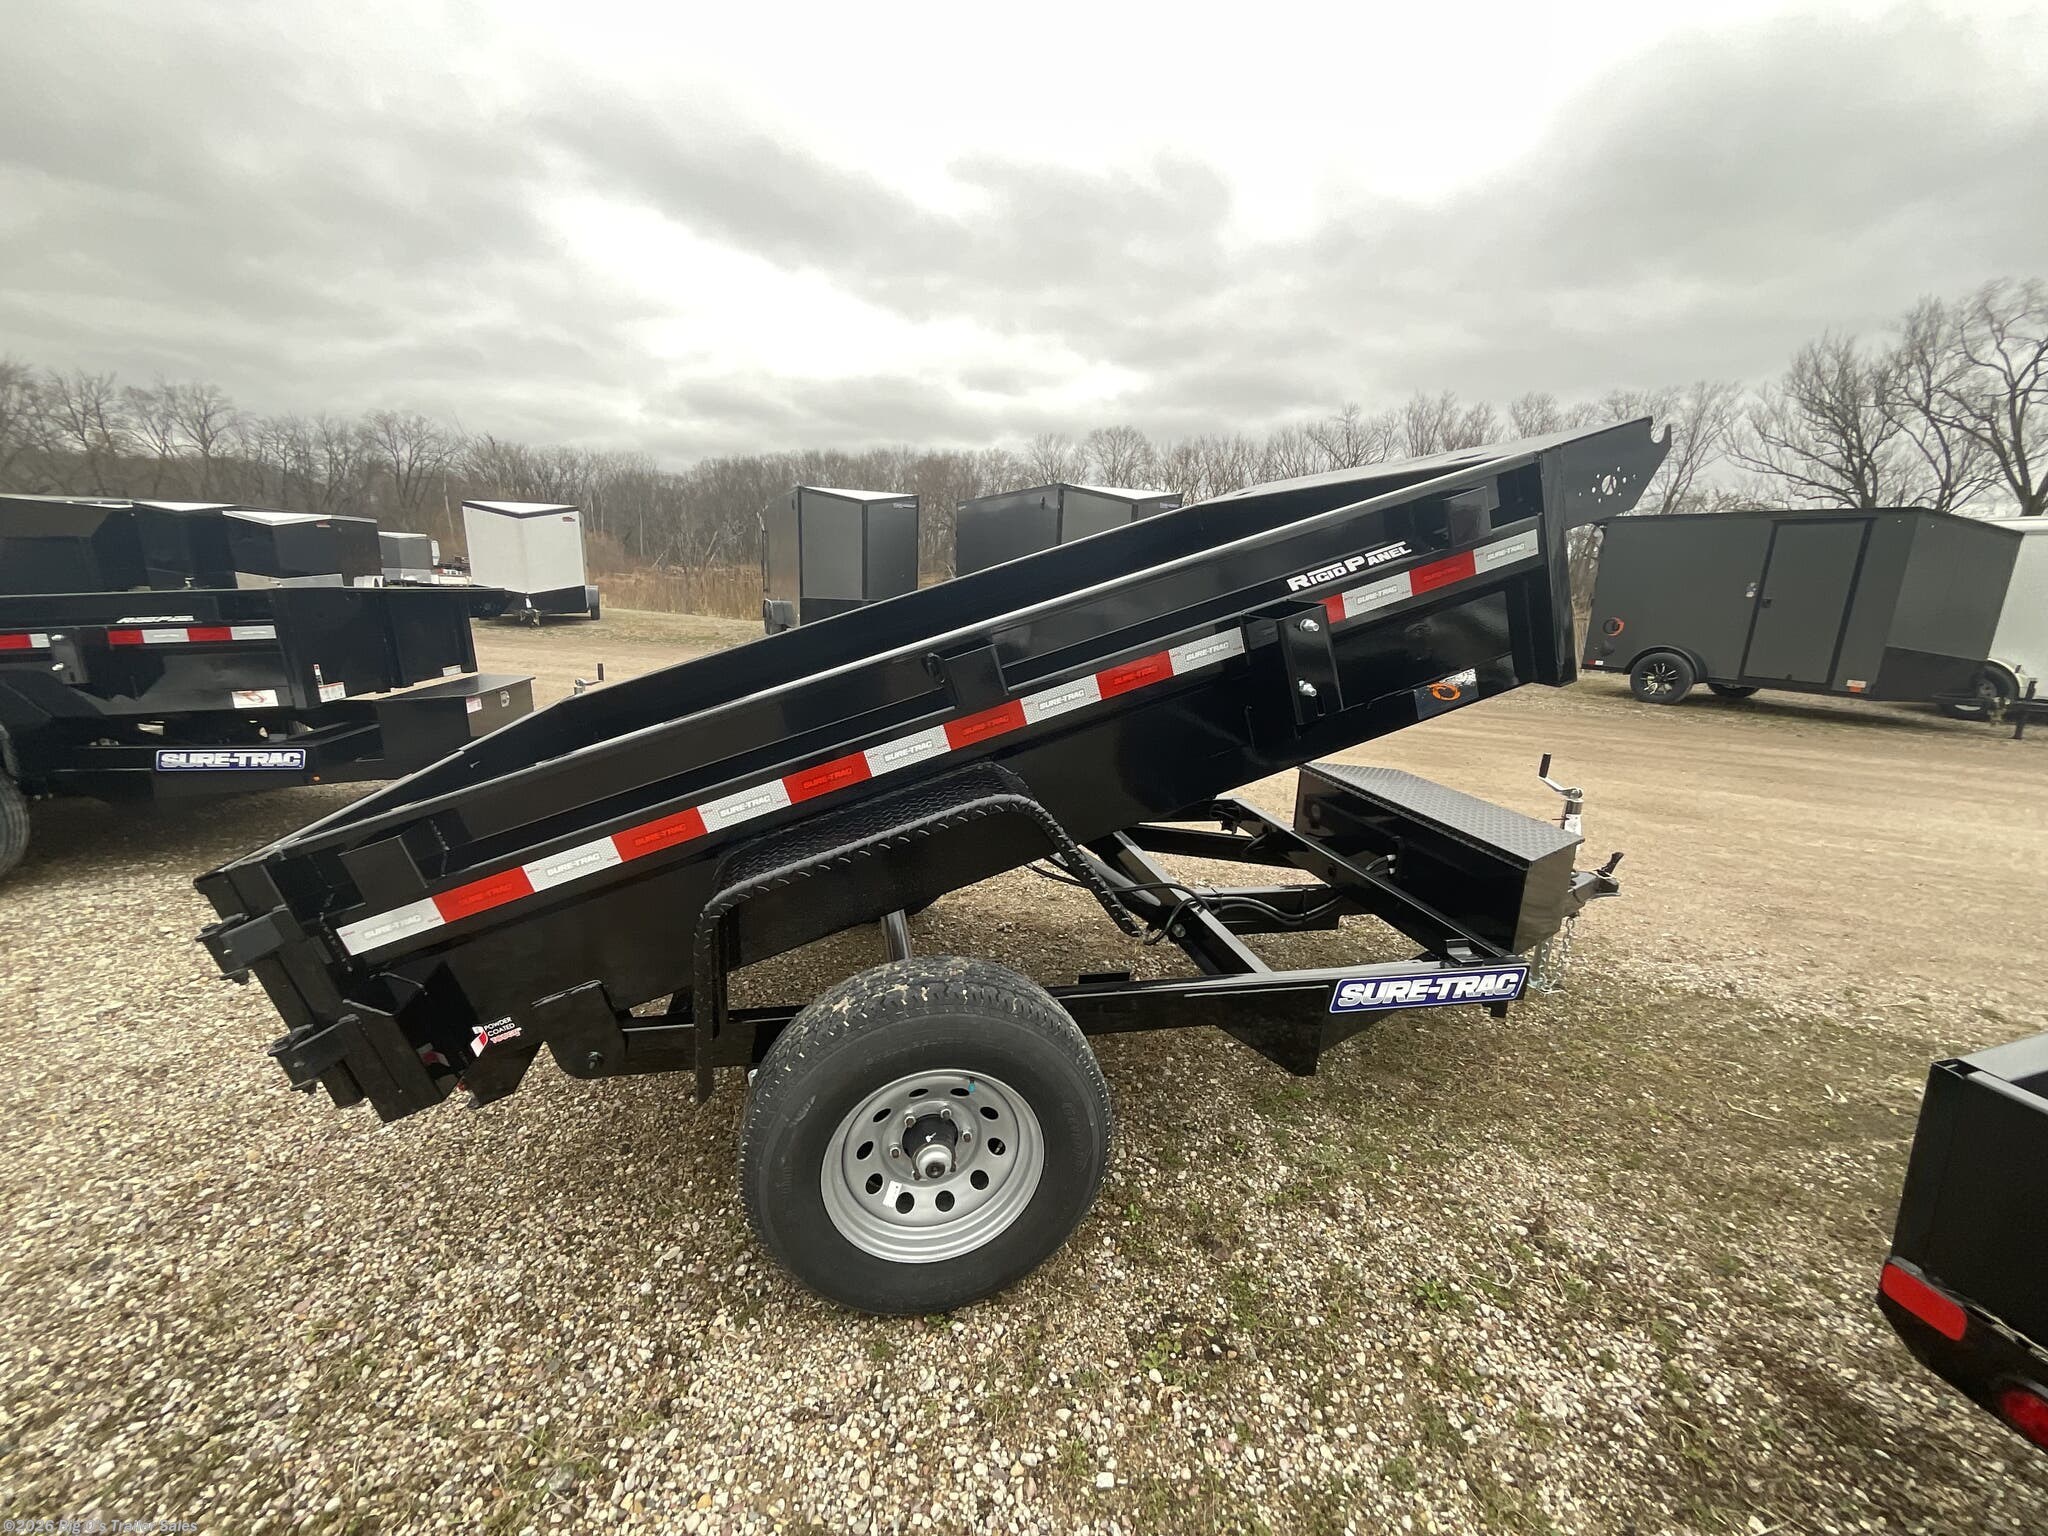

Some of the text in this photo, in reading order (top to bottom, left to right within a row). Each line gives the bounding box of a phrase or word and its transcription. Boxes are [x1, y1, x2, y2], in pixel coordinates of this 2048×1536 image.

[1186, 642, 1230, 661] SURE-TRAC
[1039, 689, 1085, 710] SURE-TRAC
[161, 752, 302, 768] SURE-TRAC
[885, 741, 933, 762] SURE-TRAC
[720, 794, 771, 817] SURE-TRAC
[548, 853, 601, 876] SURE-TRAC
[364, 914, 422, 939] SURE-TRAC
[1338, 973, 1520, 1007] SURE-TRAC
[484, 1016, 513, 1031] POWDER
[487, 1022, 516, 1037] COATED
